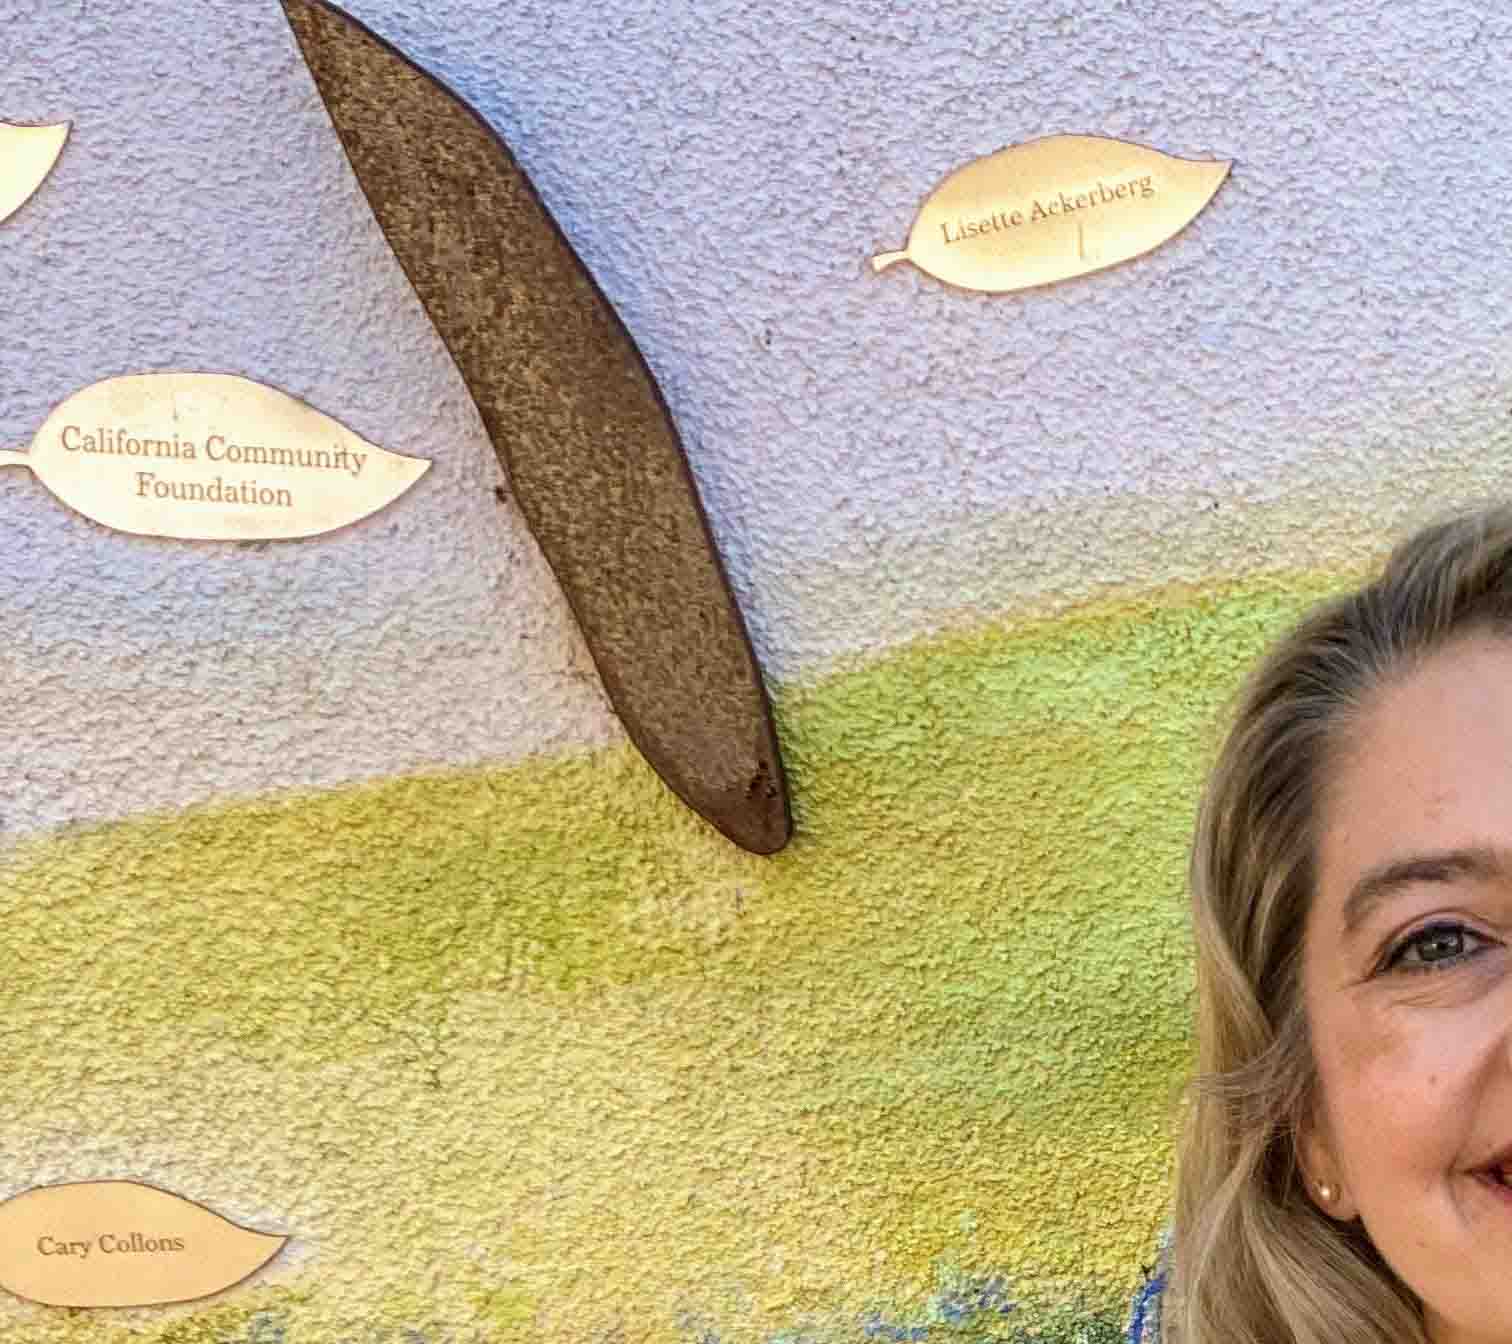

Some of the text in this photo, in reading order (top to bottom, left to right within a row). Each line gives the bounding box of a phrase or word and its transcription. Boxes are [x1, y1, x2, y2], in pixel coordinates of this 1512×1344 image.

[940, 174, 1156, 245] Lisette Ackerberg
[61, 425, 368, 477] California Community
[135, 471, 293, 507] Foundation
[37, 1235, 92, 1259] Cary
